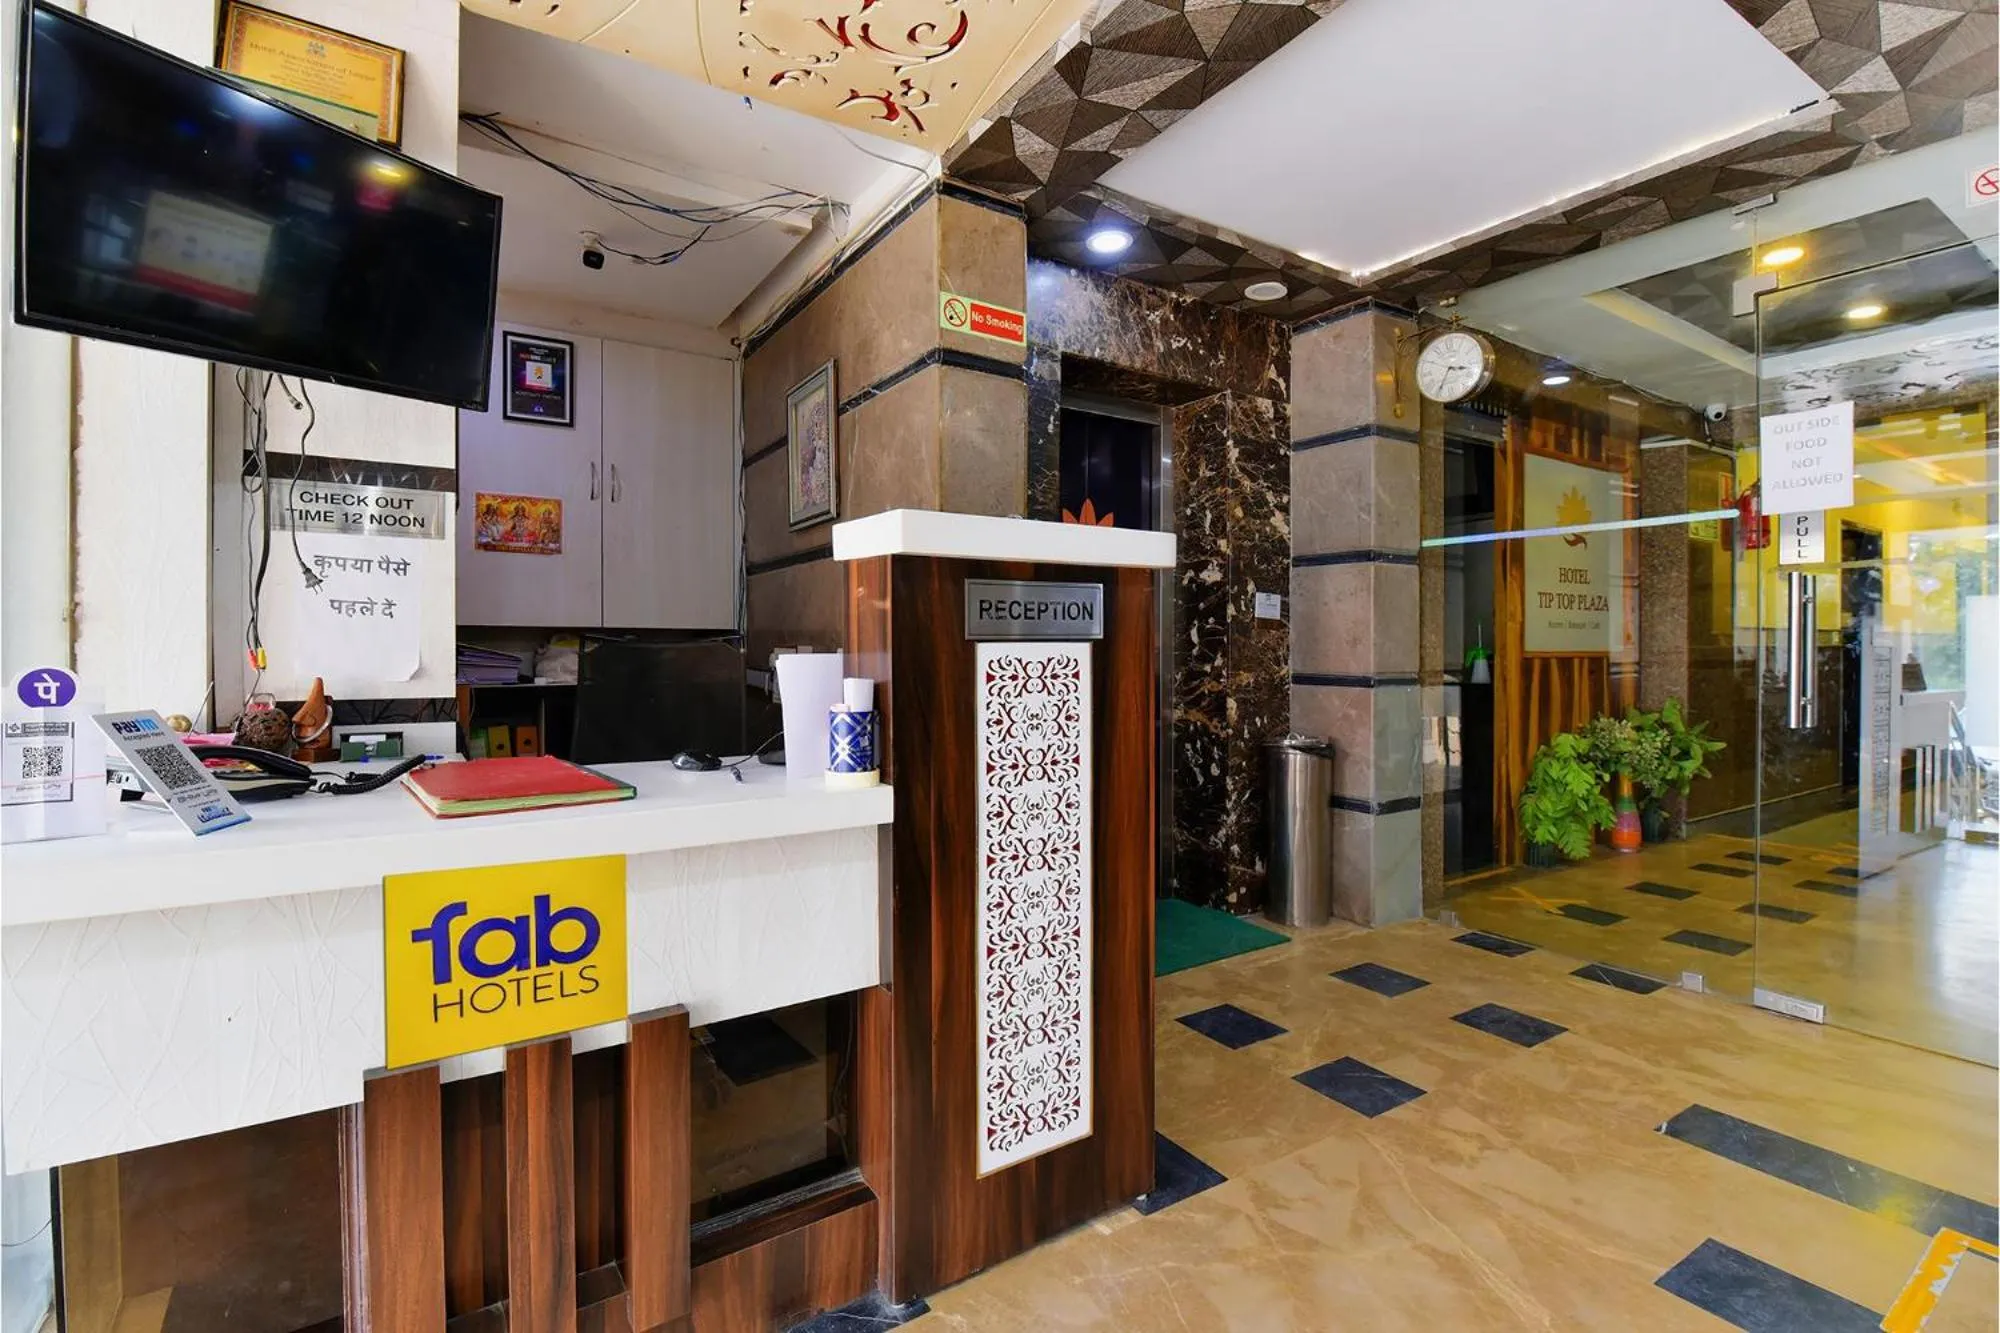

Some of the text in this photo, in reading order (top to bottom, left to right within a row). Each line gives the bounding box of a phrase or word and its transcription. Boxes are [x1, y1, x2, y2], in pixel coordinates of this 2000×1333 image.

[972, 311, 1023, 335] No Smoking
[1773, 416, 1841, 435] OUT SIDE
[1785, 437, 1828, 452] FOOD
[1791, 457, 1823, 469] NOT
[1771, 472, 1844, 490] ALLOWED
[299, 491, 414, 510] CHECK OUT
[285, 508, 425, 528] TIME 12 NOON
[1796, 515, 1809, 558] PULL
[313, 554, 411, 578] कृपया पैसे
[1558, 567, 1591, 585] HOTEL
[329, 597, 397, 619] पहले दें
[978, 599, 1094, 621] RECEPTION
[1538, 592, 1609, 612] TIP TOP PLAZA
[34, 673, 61, 705] पे
[411, 893, 601, 985] fab
[431, 964, 601, 1023] HOTELS
